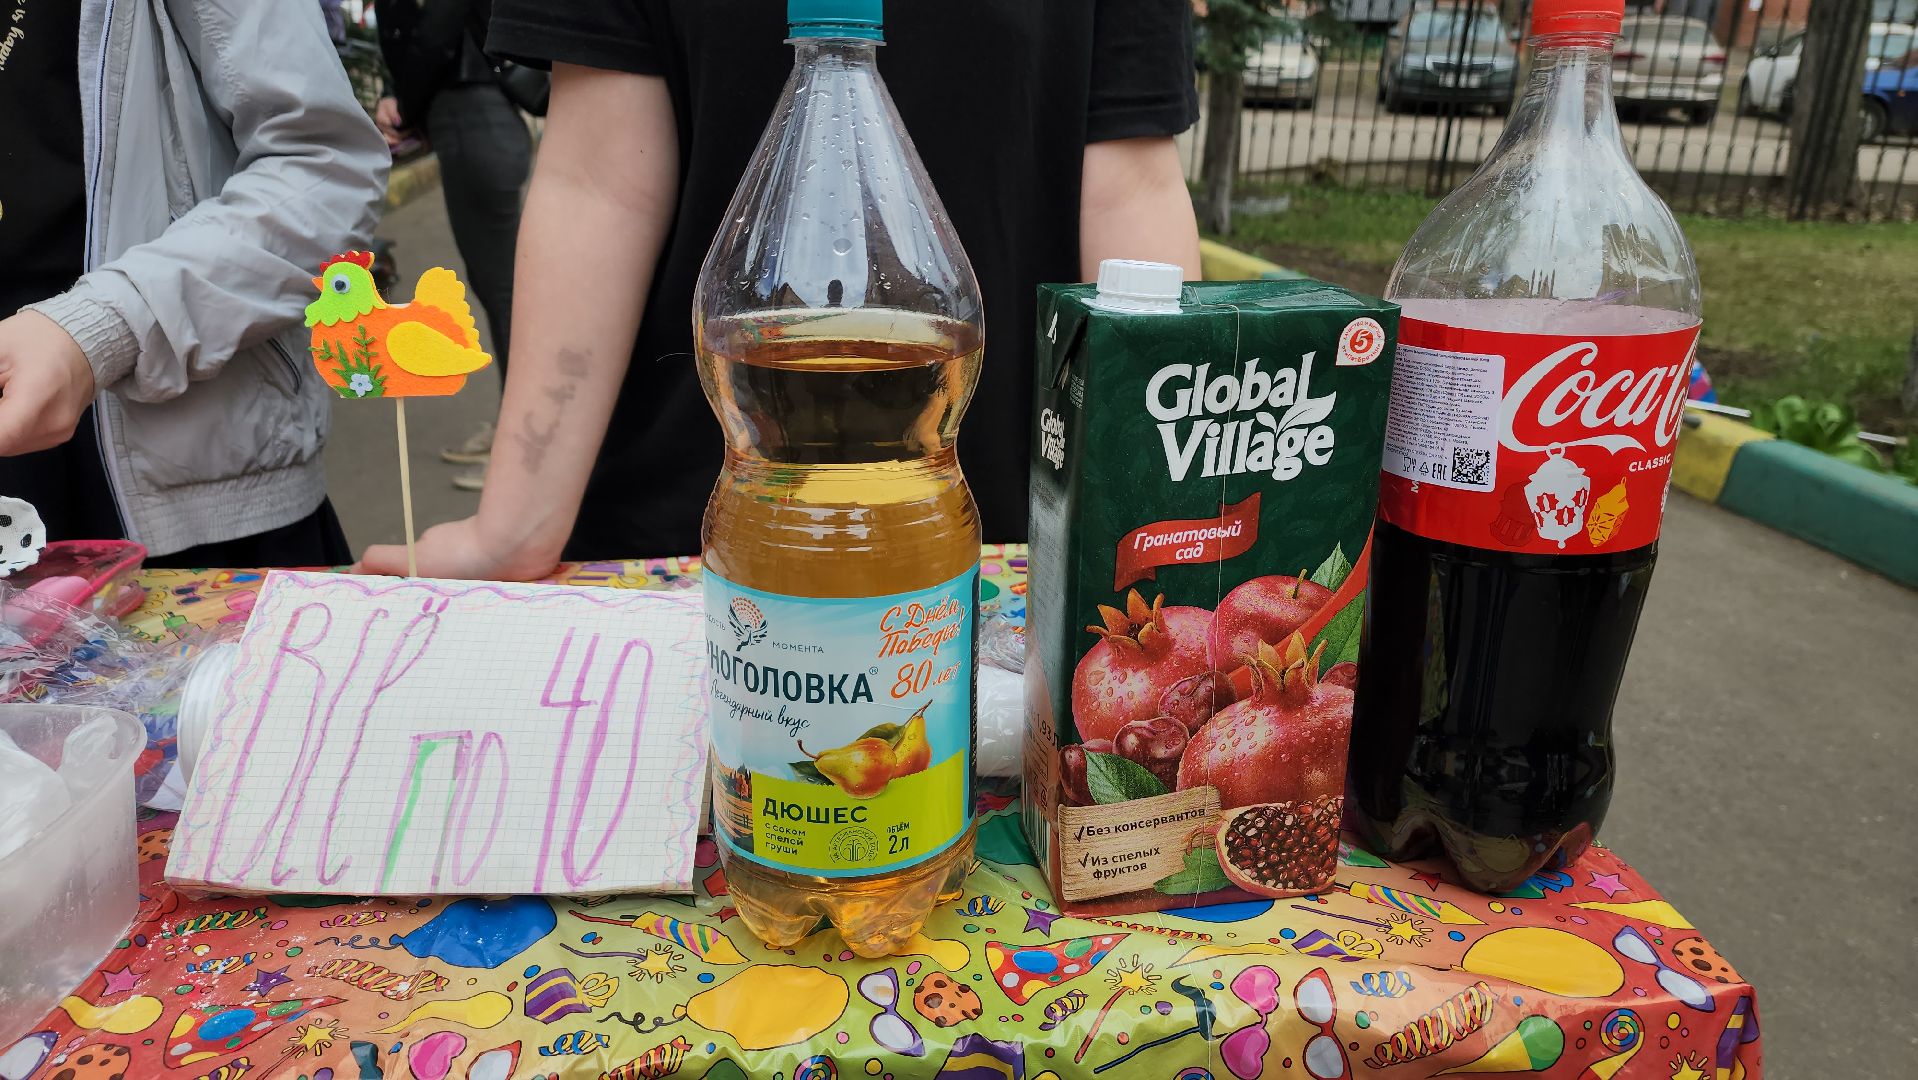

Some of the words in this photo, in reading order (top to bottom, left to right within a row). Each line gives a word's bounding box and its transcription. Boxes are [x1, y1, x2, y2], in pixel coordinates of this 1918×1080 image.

[1146, 352, 1337, 422] Global
[1157, 411, 1335, 481] Village
[1628, 453, 1672, 472] CLASSIC
[1133, 520, 1242, 551] Гранатовый
[1175, 542, 1204, 560] сад
[880, 606, 901, 632] С
[904, 595, 960, 629] Днём
[878, 606, 964, 658] Победы!
[772, 641, 825, 654] МОМЕНТА
[705, 636, 874, 705] НОГОЛОВКА
[890, 659, 933, 699] 80
[932, 661, 961, 686] лет
[711, 679, 774, 722] Легендарный
[777, 705, 811, 738] вкус
[532, 627, 654, 892] 40
[762, 797, 868, 825] ДЮШЕС
[1086, 825, 1111, 837] Без
[1114, 808, 1206, 833] консервантов
[765, 832, 804, 847] спелой
[772, 825, 807, 837] соком
[765, 841, 798, 856] груши
[1091, 855, 1109, 867] Из
[1111, 847, 1160, 864] спелых
[1092, 862, 1148, 880] фруктов
